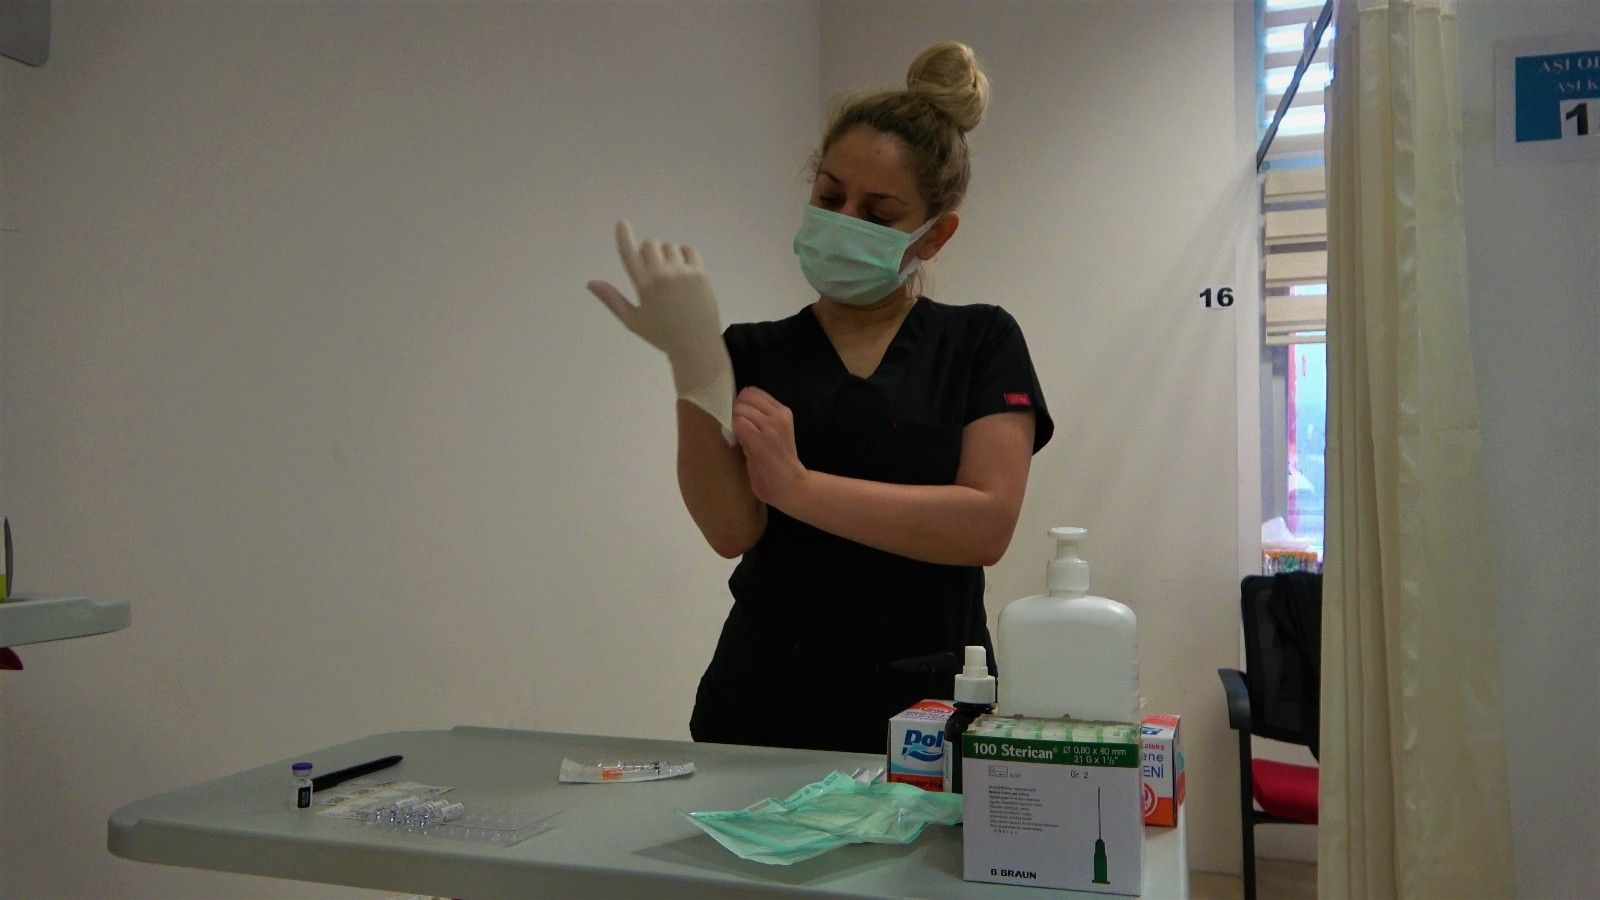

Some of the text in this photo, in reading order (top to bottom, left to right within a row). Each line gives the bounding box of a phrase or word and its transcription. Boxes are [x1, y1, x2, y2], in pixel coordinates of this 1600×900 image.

[1588, 79, 1600, 90] K
[1565, 102, 1588, 136] 1
[1199, 286, 1234, 308] 16
[904, 729, 945, 748] Dol
[973, 742, 997, 755] 100
[1111, 748, 1127, 756] mm
[1144, 743, 1165, 751] ateks
[1073, 755, 1083, 763] 21
[1085, 756, 1093, 764] G
[1083, 771, 1089, 779] 2
[990, 868, 1037, 880] B BRAUN
